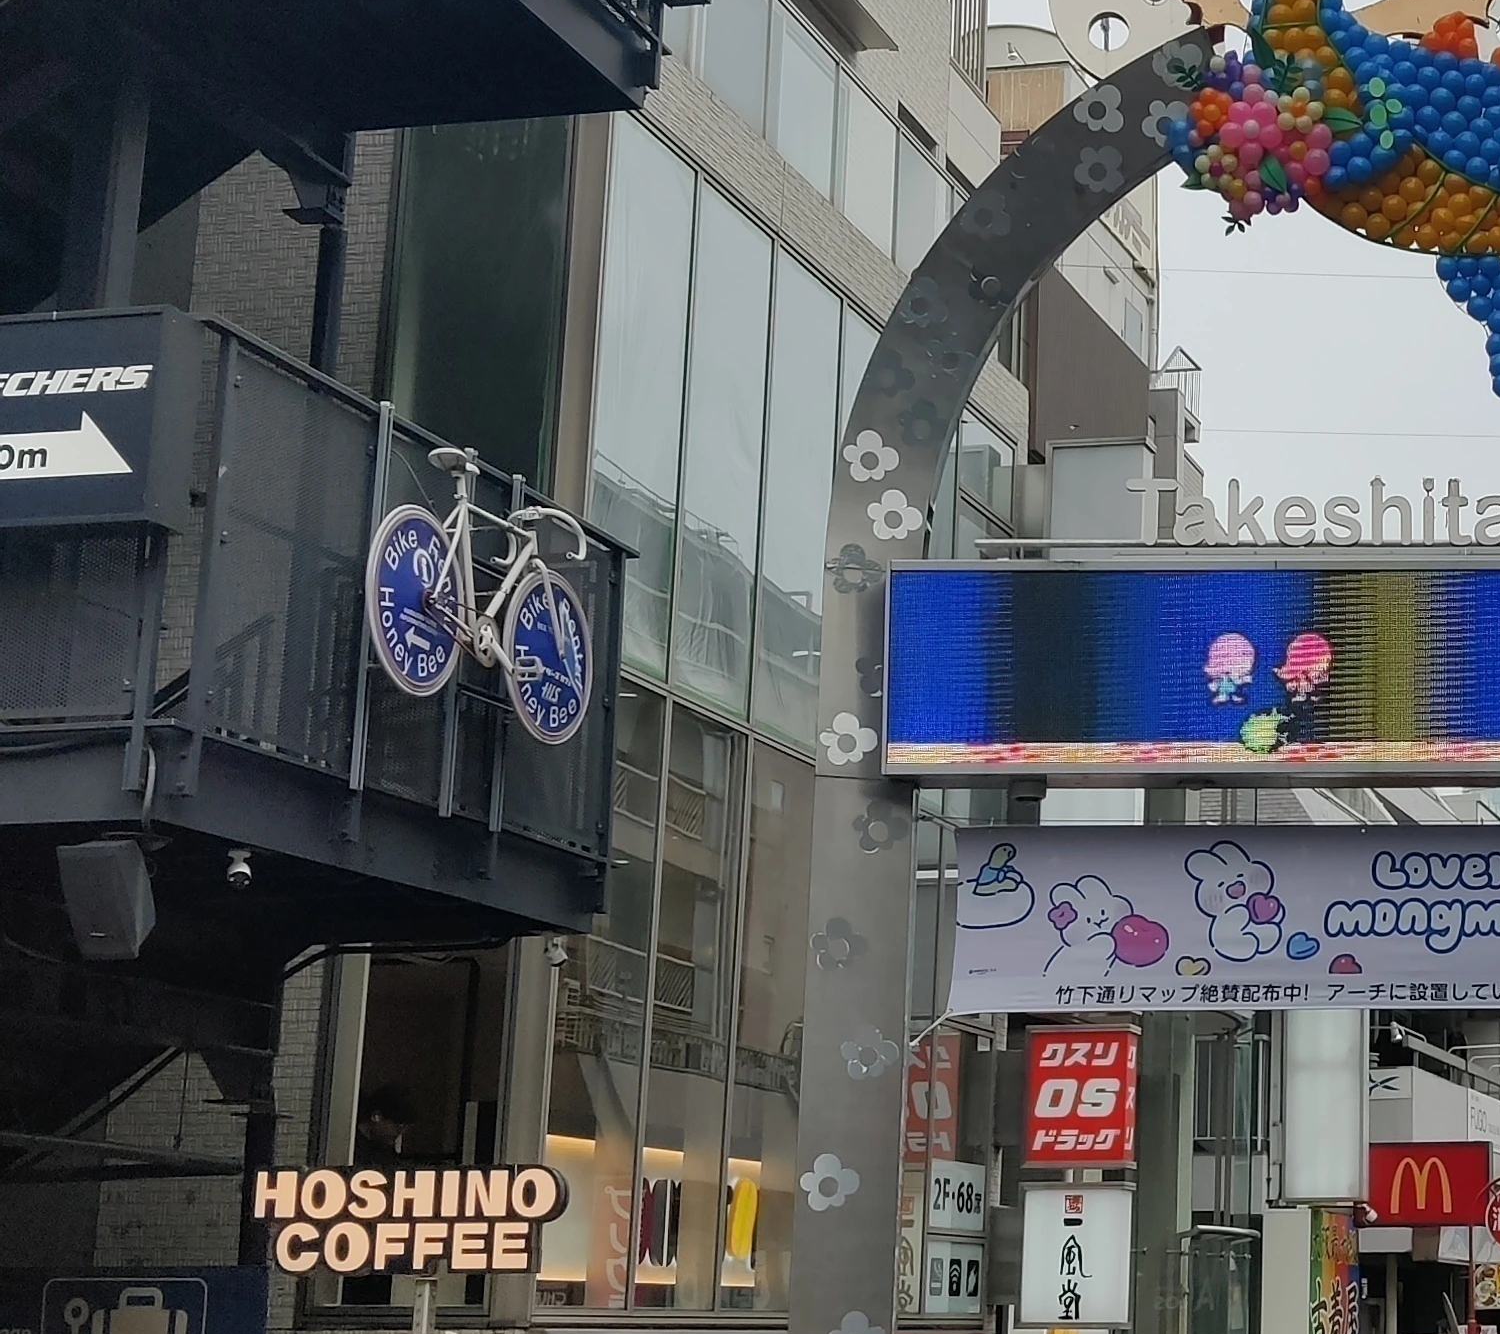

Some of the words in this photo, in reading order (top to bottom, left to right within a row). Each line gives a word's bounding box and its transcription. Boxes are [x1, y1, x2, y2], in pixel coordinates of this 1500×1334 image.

[385, 530, 418, 571] Bike
[379, 586, 413, 677] Honey
[417, 644, 447, 678] Bee
[519, 591, 551, 632] Bike
[514, 643, 547, 727] Hney
[549, 697, 578, 728] Bee
[1038, 1042, 1120, 1067] クスリ
[1034, 1077, 1121, 1118] OS
[1031, 1128, 1122, 1151] ドラッグ
[253, 1167, 557, 1219] HOSHINO
[276, 1220, 530, 1272] COFFEE
[1058, 1217, 1093, 1320] 一風堂
